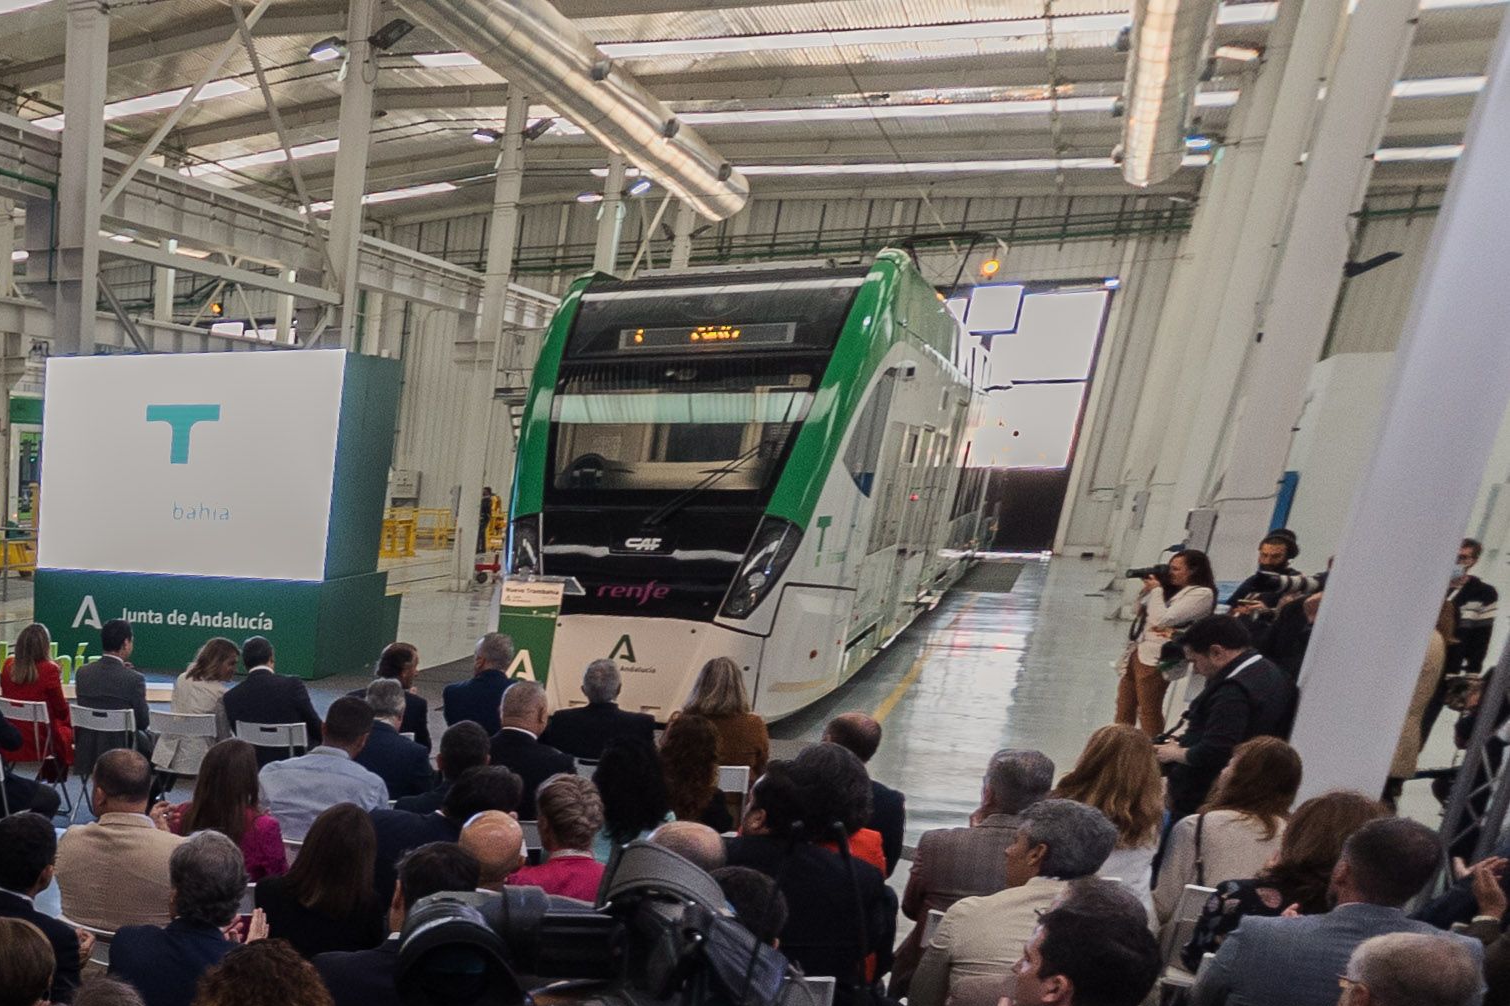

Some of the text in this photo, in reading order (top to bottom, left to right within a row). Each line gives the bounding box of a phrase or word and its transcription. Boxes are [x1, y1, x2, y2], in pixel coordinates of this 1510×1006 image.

[625, 537, 662, 550] CAF
[596, 580, 671, 606] renfe
[118, 608, 273, 630] Junta de Andalucía
